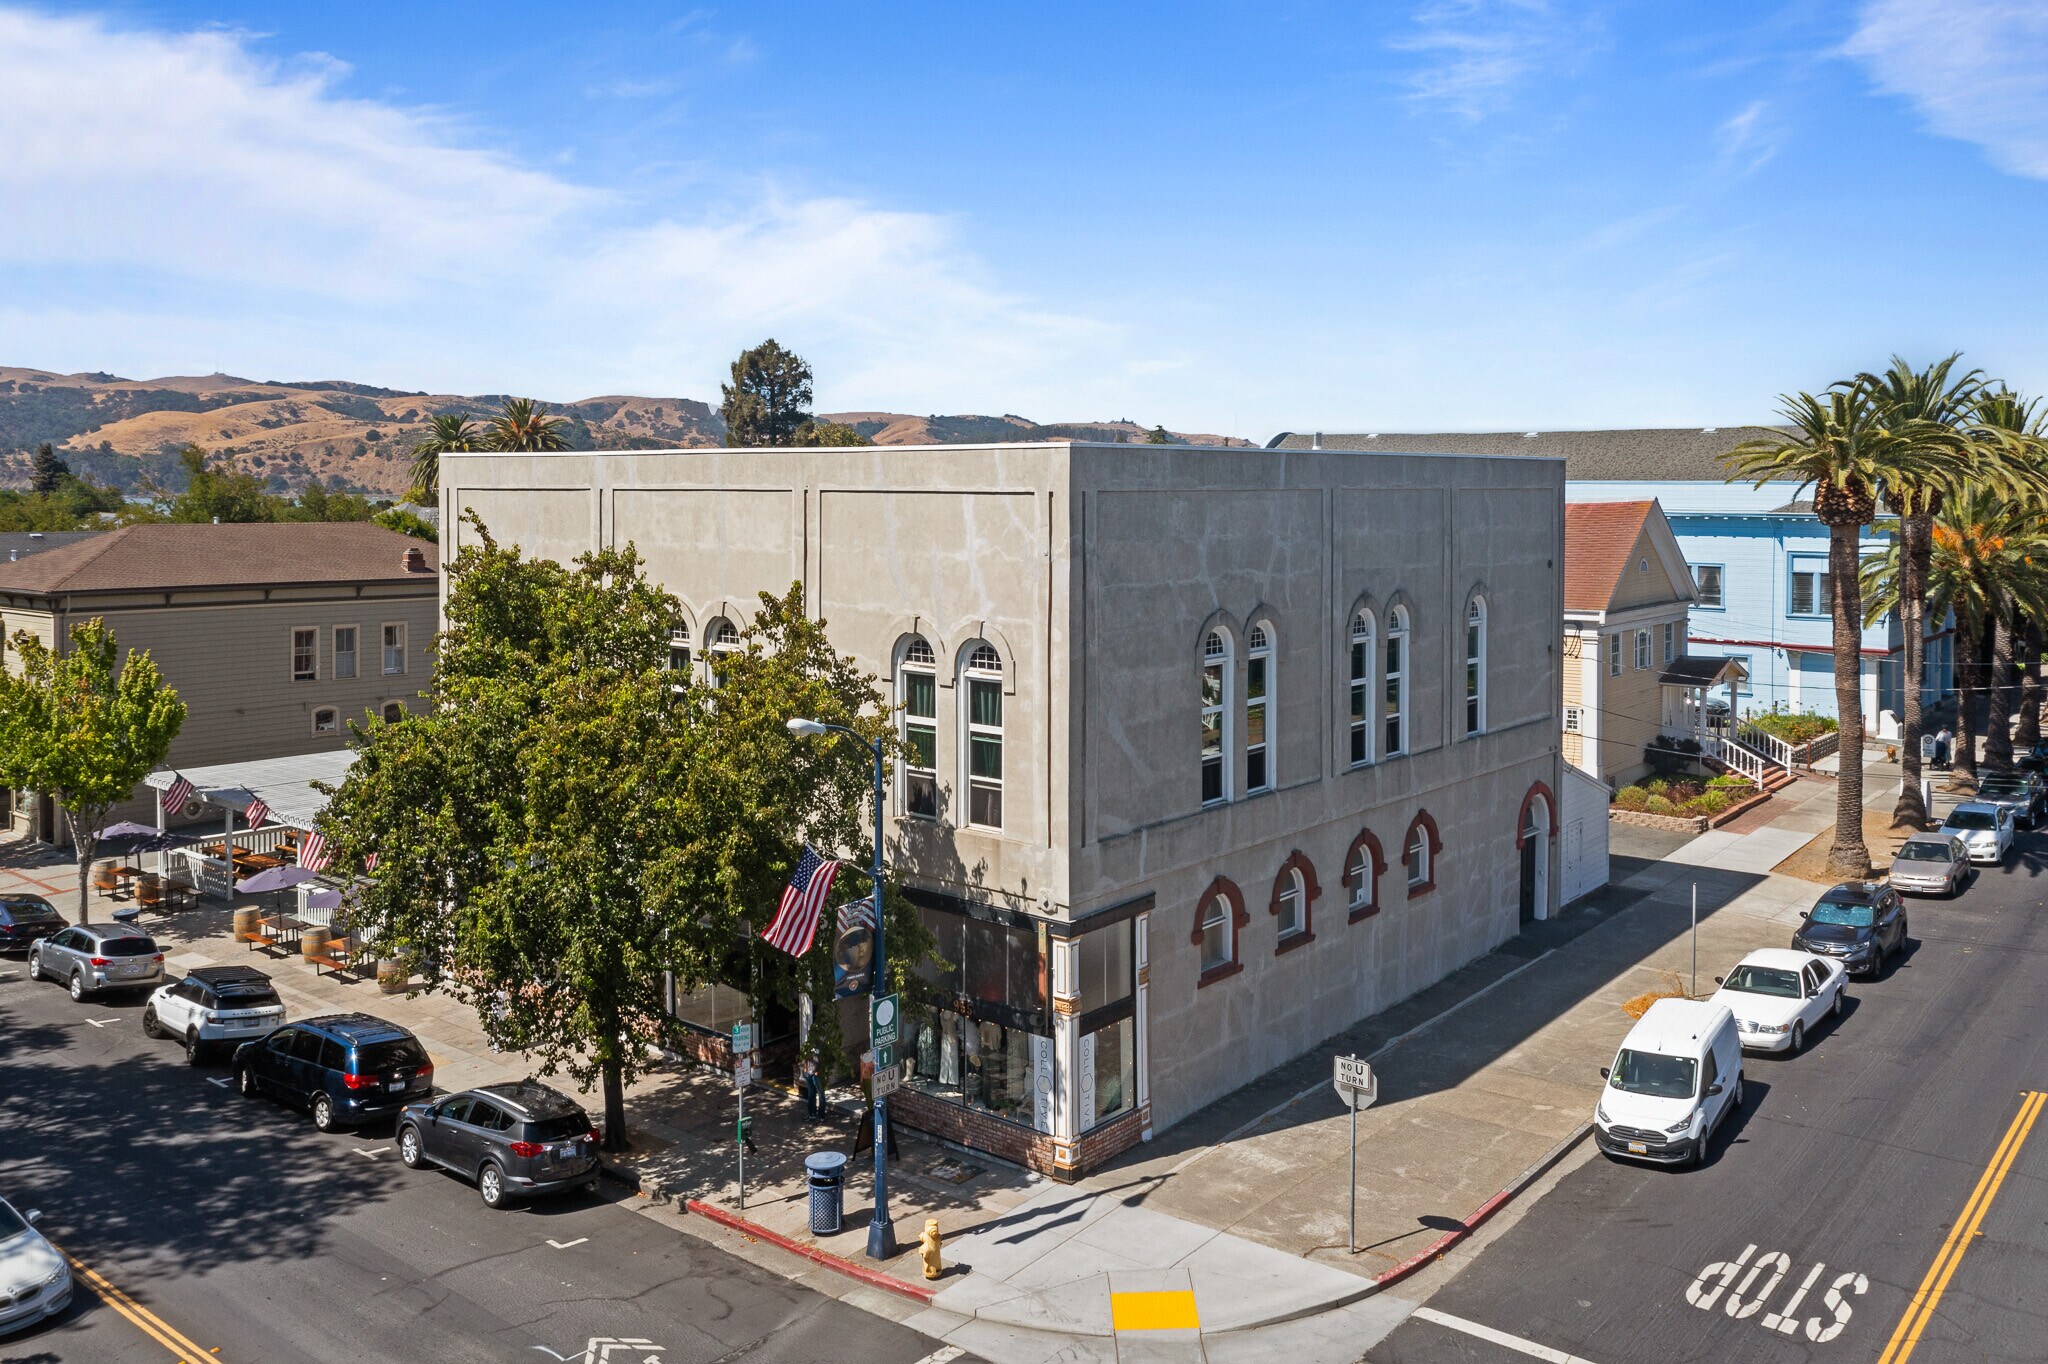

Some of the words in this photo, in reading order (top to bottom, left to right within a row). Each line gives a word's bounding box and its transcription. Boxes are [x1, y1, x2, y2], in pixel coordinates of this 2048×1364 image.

[876, 1024, 894, 1036] PUBLIC
[874, 1032, 896, 1046] PARKING
[1341, 1062, 1352, 1071] NO
[1355, 1064, 1363, 1075] U
[876, 1074, 886, 1084] NO
[888, 1069, 895, 1080] U
[1341, 1073, 1363, 1086] TURN
[877, 1084, 895, 1095] TURN
[1686, 1244, 1869, 1343] STOP
